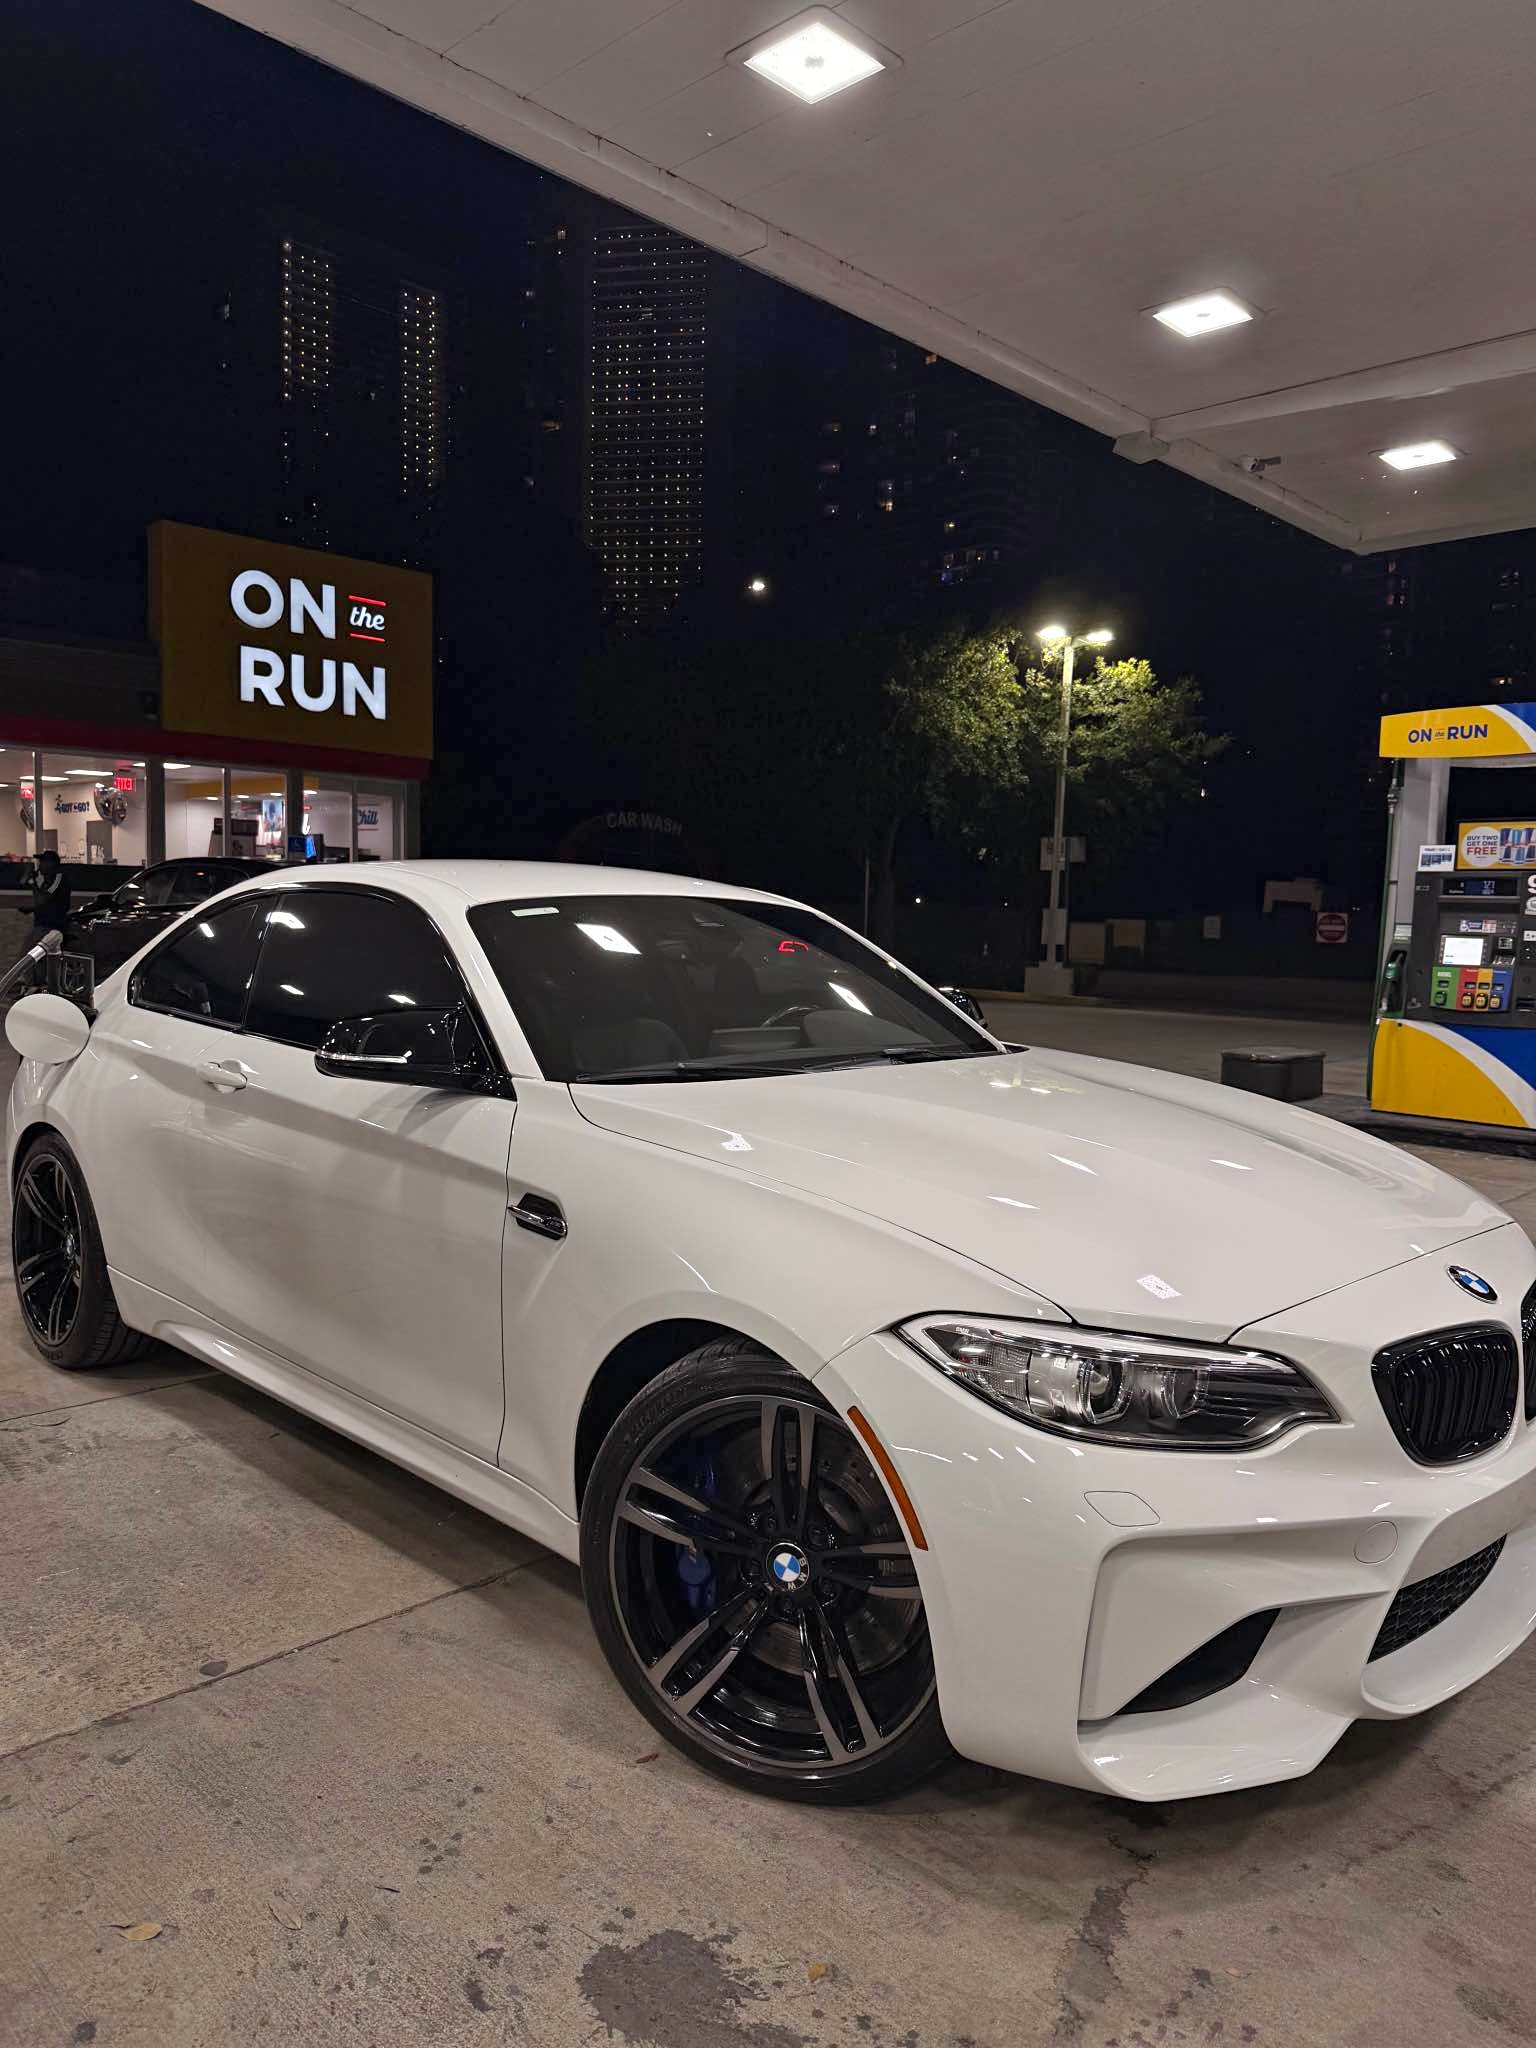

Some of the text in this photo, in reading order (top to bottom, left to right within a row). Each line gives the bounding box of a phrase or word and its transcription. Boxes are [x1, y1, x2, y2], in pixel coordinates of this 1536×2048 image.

[231, 570, 385, 639] ON the
[240, 645, 386, 720] RUN
[1408, 728, 1432, 743] ON
[1447, 724, 1488, 740] RUN
[606, 811, 683, 836] CAR WASH
[1466, 847, 1497, 855] FREE
[955, 1326, 970, 1334] BMW
